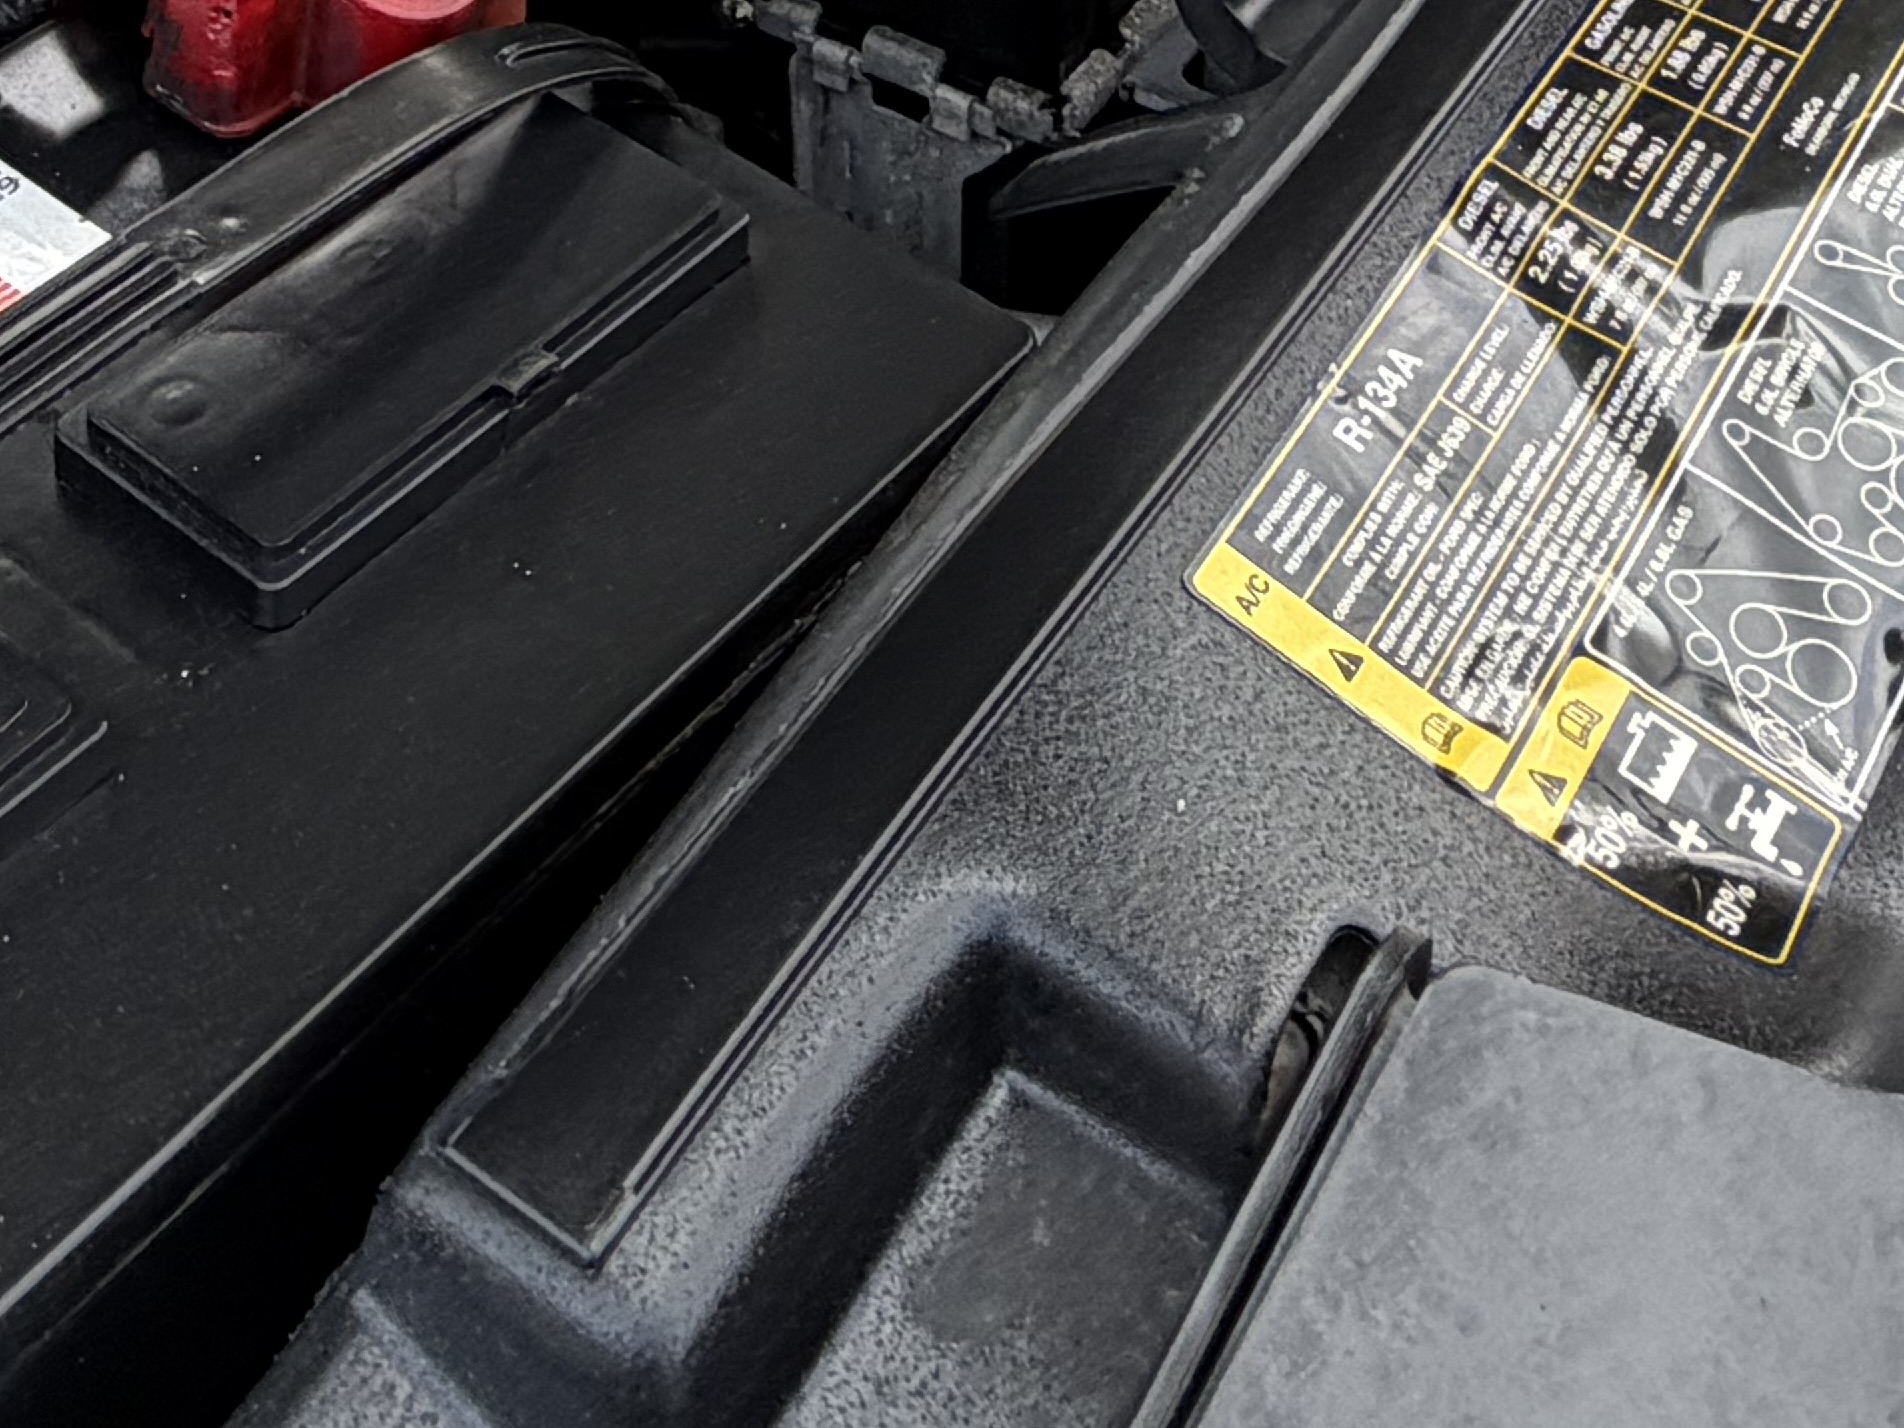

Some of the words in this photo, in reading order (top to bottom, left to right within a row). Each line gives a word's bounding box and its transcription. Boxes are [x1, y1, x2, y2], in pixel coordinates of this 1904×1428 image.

[1677, 26, 1707, 52] lbs
[1525, 83, 1568, 130] DIESEL
[1782, 94, 1825, 147] FoMoCo
[1540, 128, 1562, 150] AND
[1614, 118, 1645, 147] lbs
[1846, 162, 1879, 203] DIESEL
[1876, 155, 1904, 189] DUAL
[1453, 177, 1502, 231] DIESEL
[1463, 221, 1498, 260] FRONT
[1486, 200, 1510, 223] A/C
[1494, 254, 1517, 277] A/C
[1525, 240, 1566, 284] 2.25
[1450, 358, 1487, 402] CHARGE
[1735, 355, 1772, 404] DIESEL
[1769, 338, 1828, 426] ALTERNATOR
[1770, 337, 1805, 383] SINGLE
[1331, 345, 1423, 452] R-134A
[1484, 386, 1517, 426] CARGA
[1507, 370, 1526, 389] DE
[1593, 452, 1638, 514] ATENDIDO
[1627, 414, 1659, 454] SOLO
[1648, 385, 1675, 417] POR
[1612, 418, 1634, 441] UN
[1411, 451, 1448, 492] SAE
[1433, 415, 1472, 458] J639
[1339, 511, 1384, 567] COMPLIES
[1374, 477, 1405, 513] WITH:
[1433, 531, 1483, 599] CONFORME
[1509, 442, 1538, 476] FORD
[1437, 517, 1468, 555] FORD
[1664, 503, 1695, 541] GAS
[1331, 560, 1378, 622] CONFORME
[1374, 534, 1394, 554] LA
[1382, 532, 1421, 580] CUMPLE
[1469, 590, 1510, 643] SYSTEM
[1499, 570, 1521, 593] TO
[1510, 554, 1531, 575] BE
[1553, 482, 1574, 504] BY
[1232, 572, 1272, 615] A/C
[1447, 582, 1475, 617] PARA
[1512, 591, 1534, 615] NE
[1586, 805, 1638, 870] 50%
[1706, 878, 1756, 937] 50%
